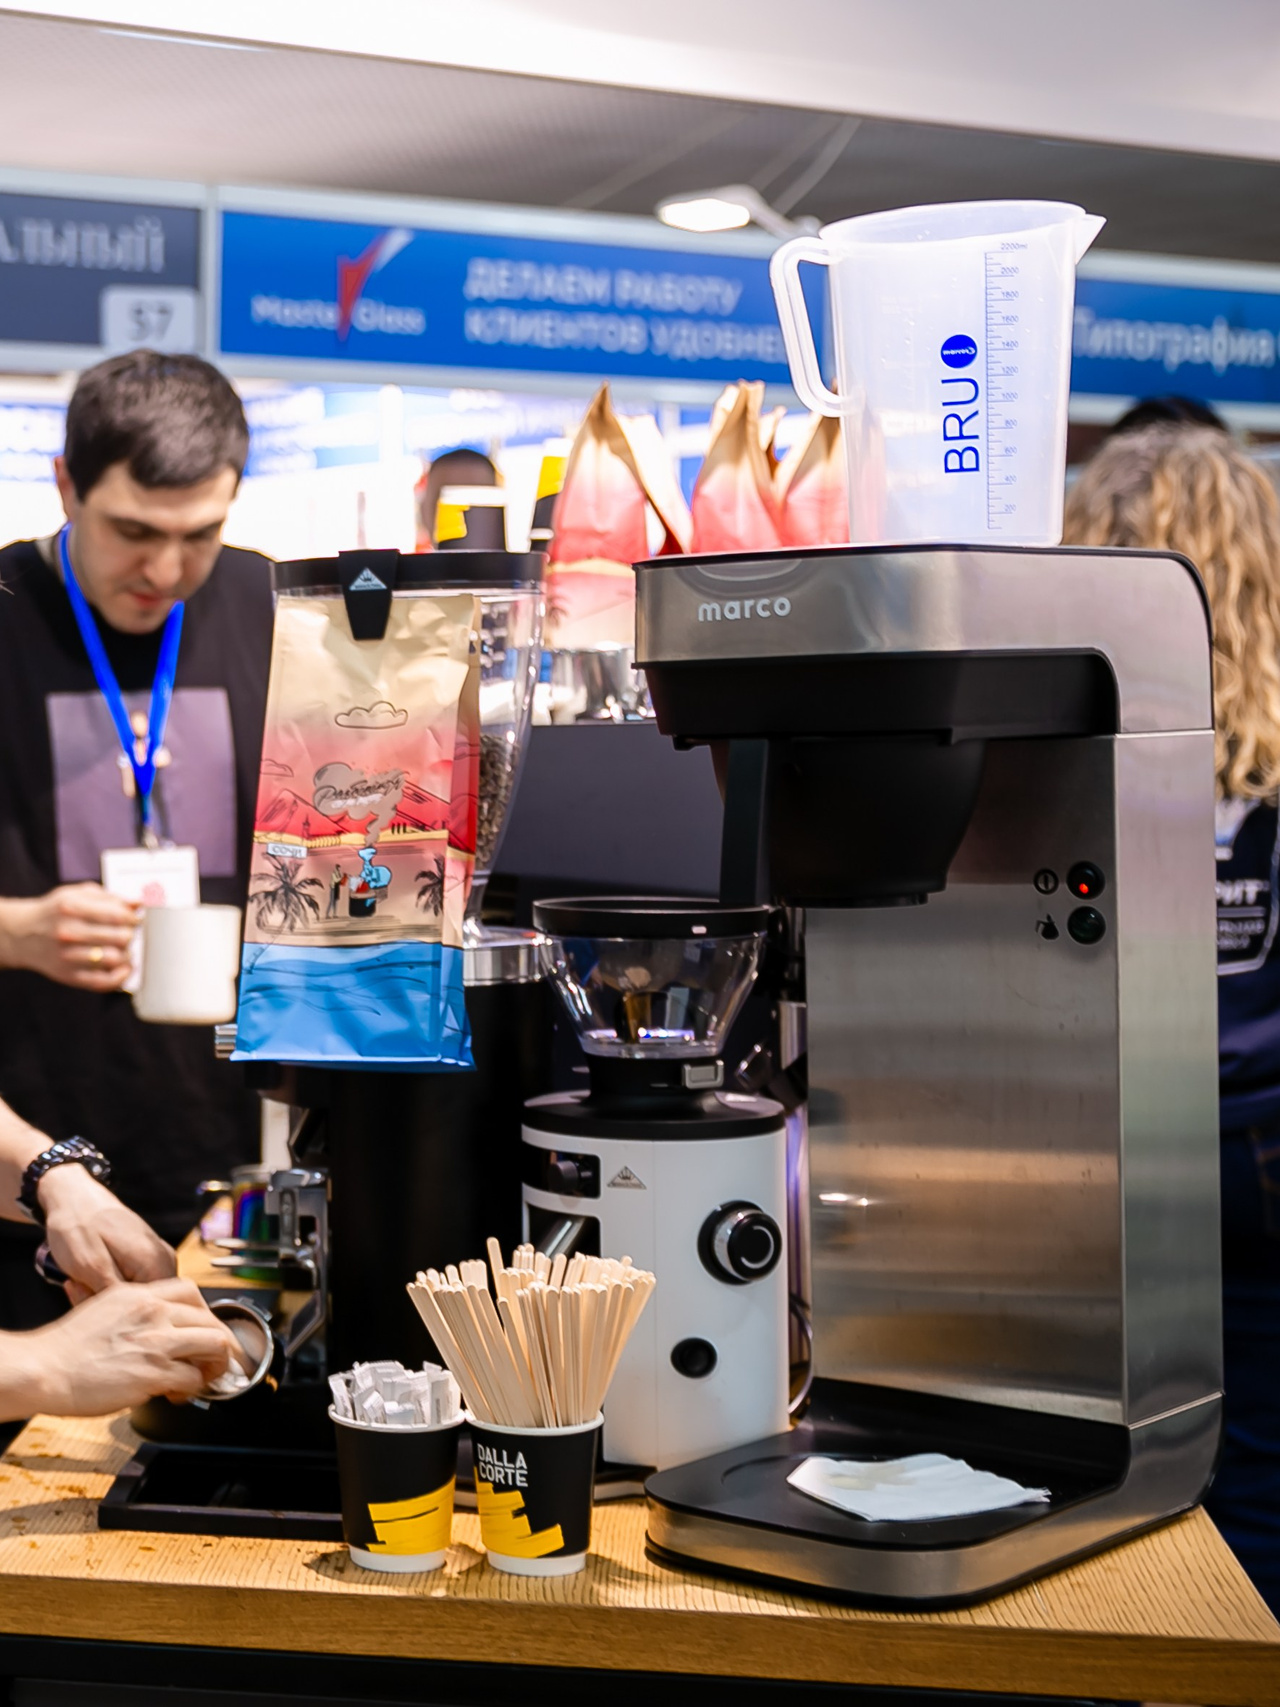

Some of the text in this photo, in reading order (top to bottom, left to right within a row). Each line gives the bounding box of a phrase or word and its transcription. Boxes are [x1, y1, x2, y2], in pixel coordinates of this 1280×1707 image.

[463, 257, 743, 316] ДЕЛАЕМ РАБОТУ
[464, 306, 648, 354] КЛИЕНТОВ
[941, 378, 980, 473] BRU
[698, 597, 792, 622] marco
[477, 1443, 528, 1470] DALLA
[479, 1461, 528, 1487] CORTE
